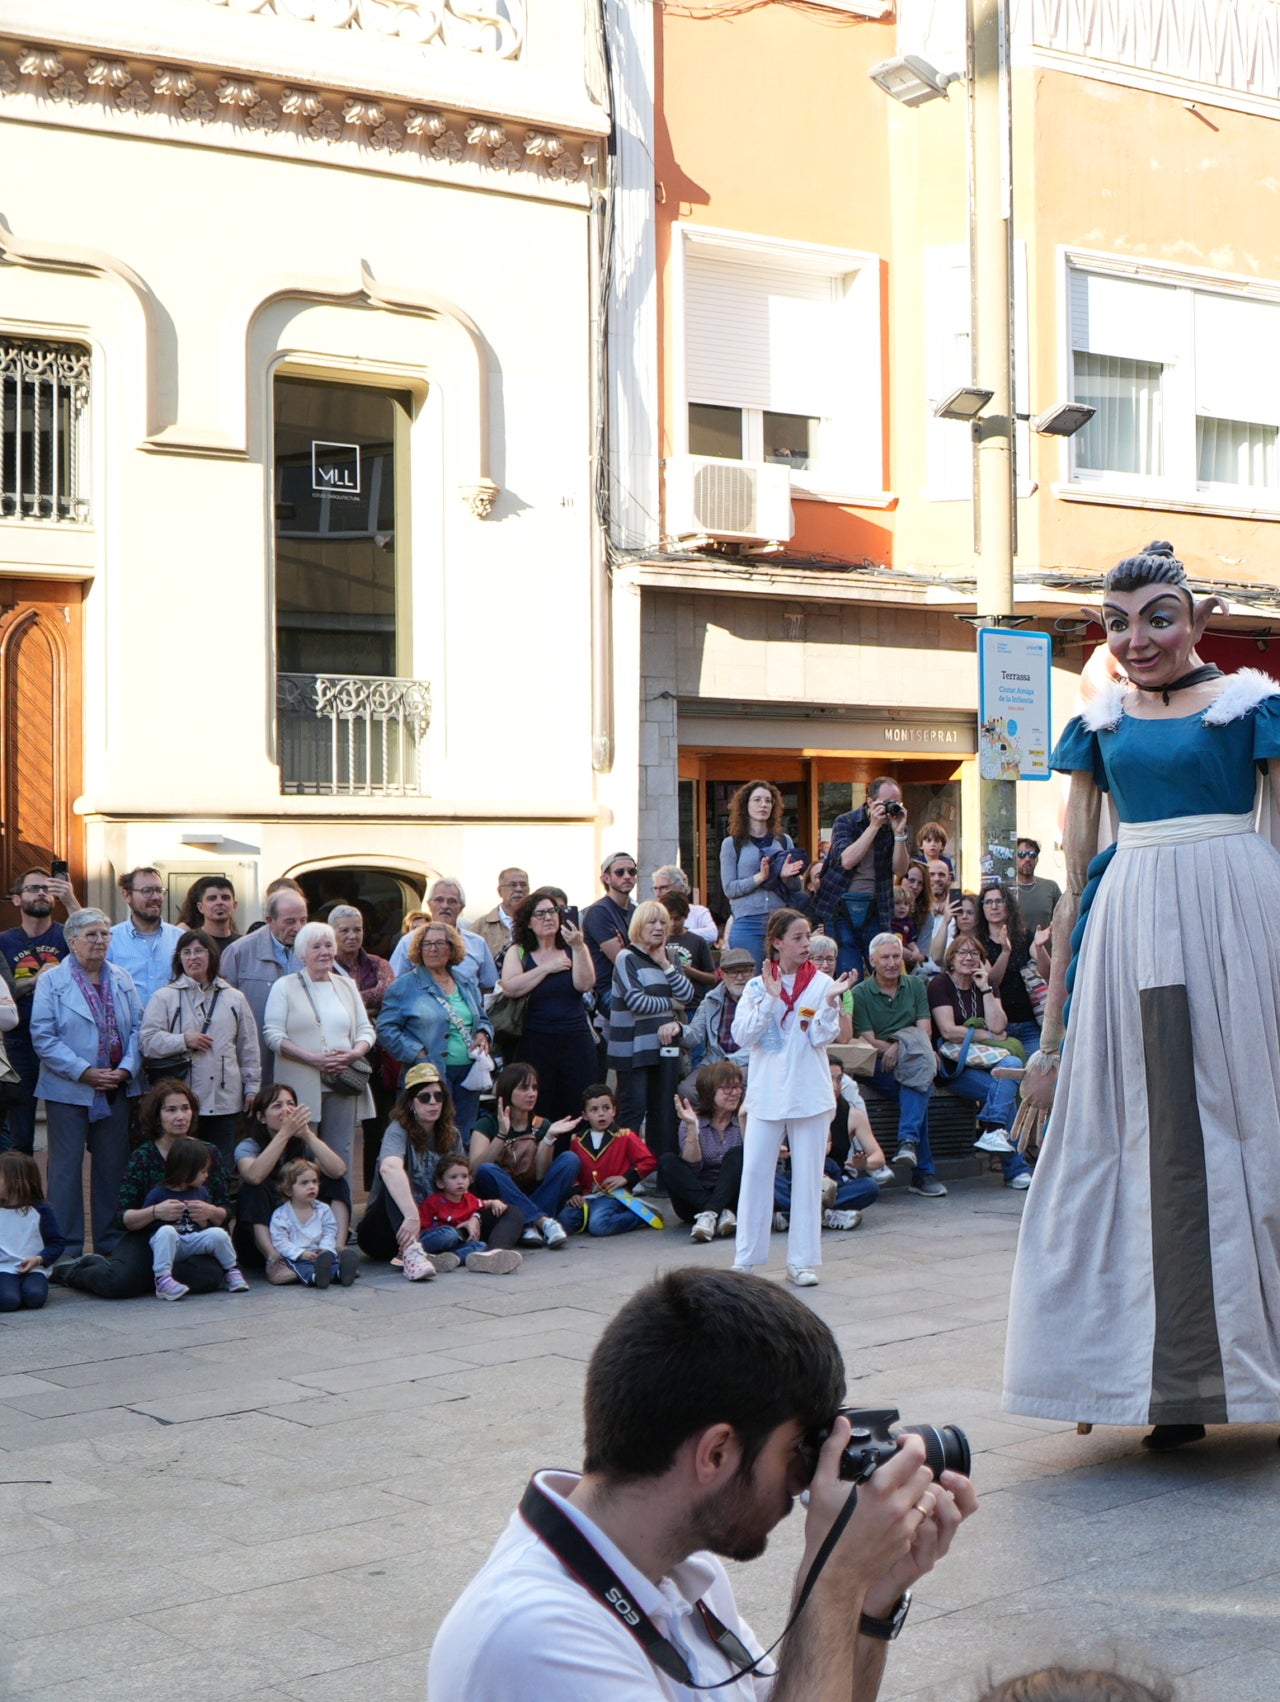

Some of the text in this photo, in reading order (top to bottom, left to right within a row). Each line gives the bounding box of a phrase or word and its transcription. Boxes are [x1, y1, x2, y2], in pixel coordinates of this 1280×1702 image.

[1001, 670, 1031, 682] Terrassa
[884, 728, 957, 743] MONTSERRAT
[604, 1587, 641, 1627] EOS
